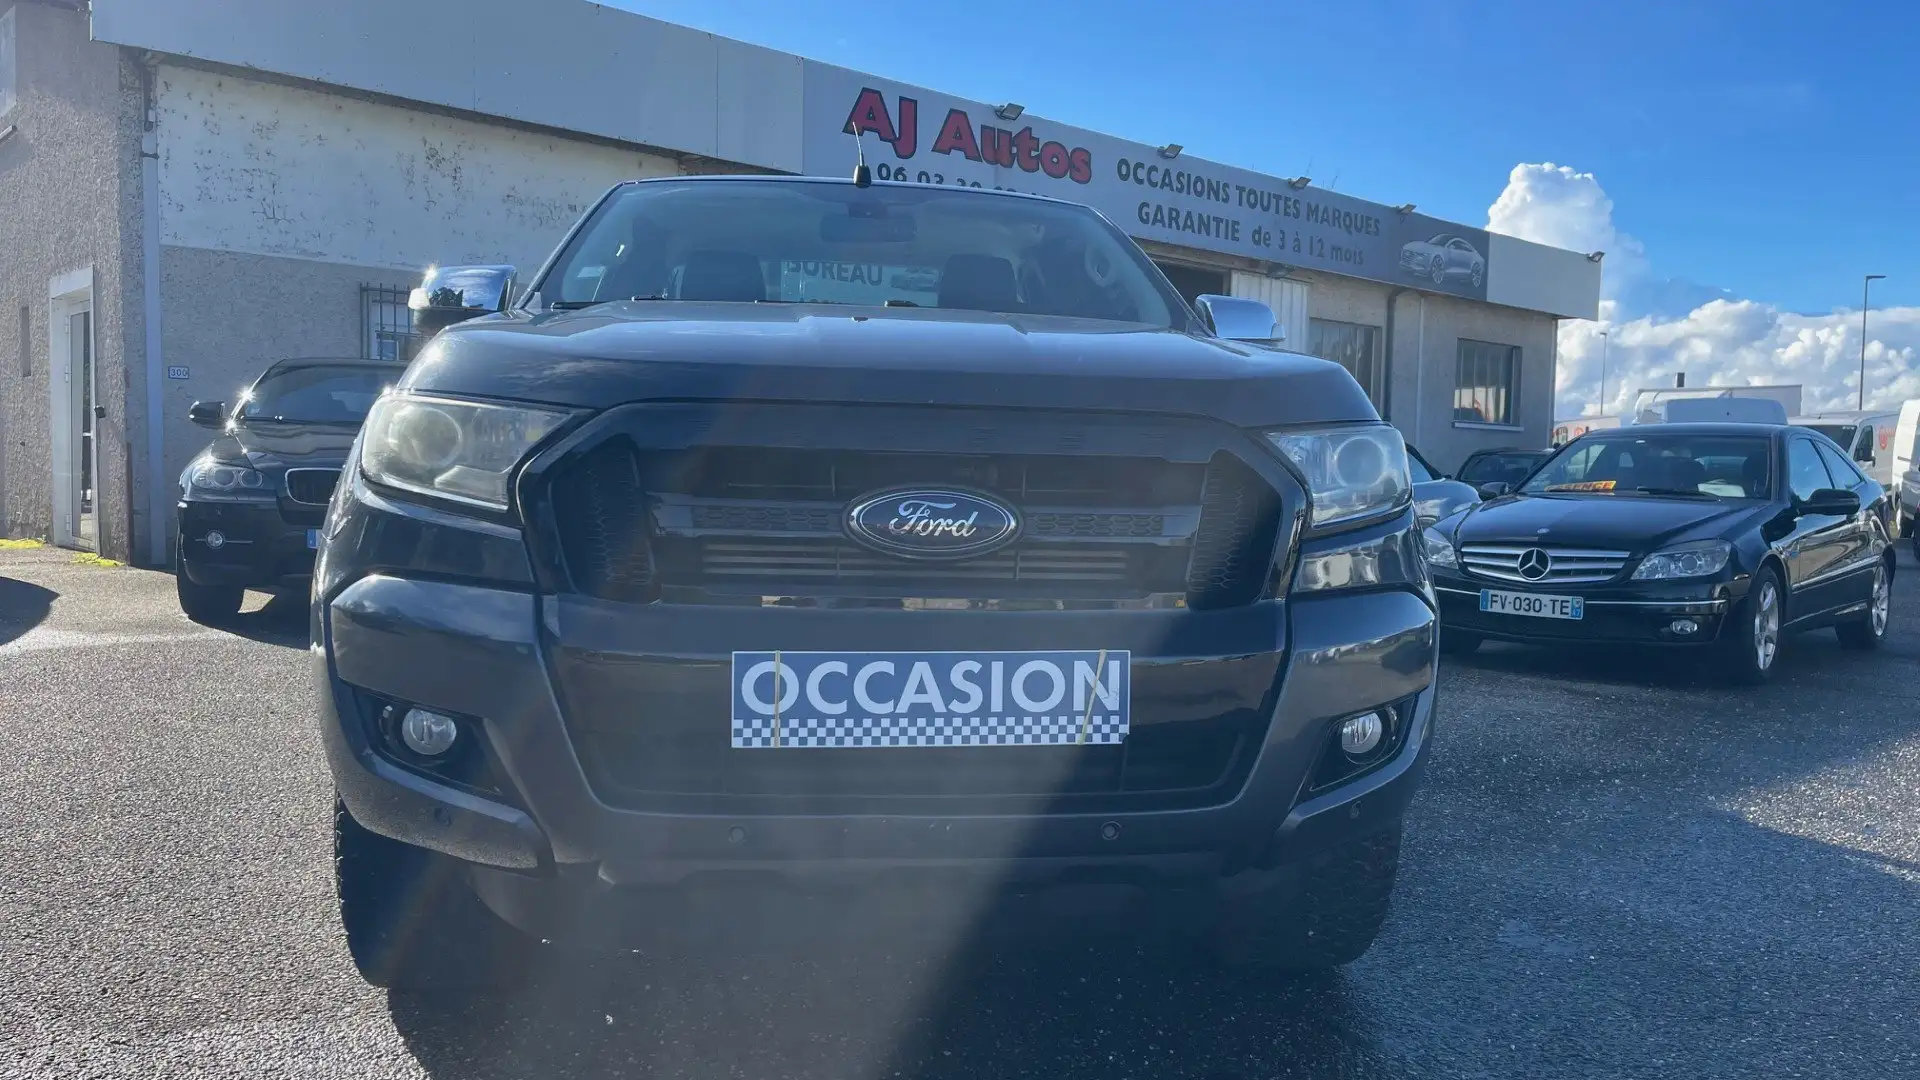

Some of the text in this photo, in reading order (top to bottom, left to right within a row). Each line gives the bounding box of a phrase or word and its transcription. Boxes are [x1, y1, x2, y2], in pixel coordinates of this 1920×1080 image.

[841, 86, 1093, 186] AJ Autos
[877, 162, 908, 182] 06
[1116, 157, 1381, 237] OCCASIONS TOUTES MARQUES
[1137, 201, 1365, 266] GARANTIE de 3 à 12 mois
[888, 500, 979, 537] Ford
[1489, 594, 1571, 616] FV-030-TE
[741, 660, 1120, 714] OCCASION
